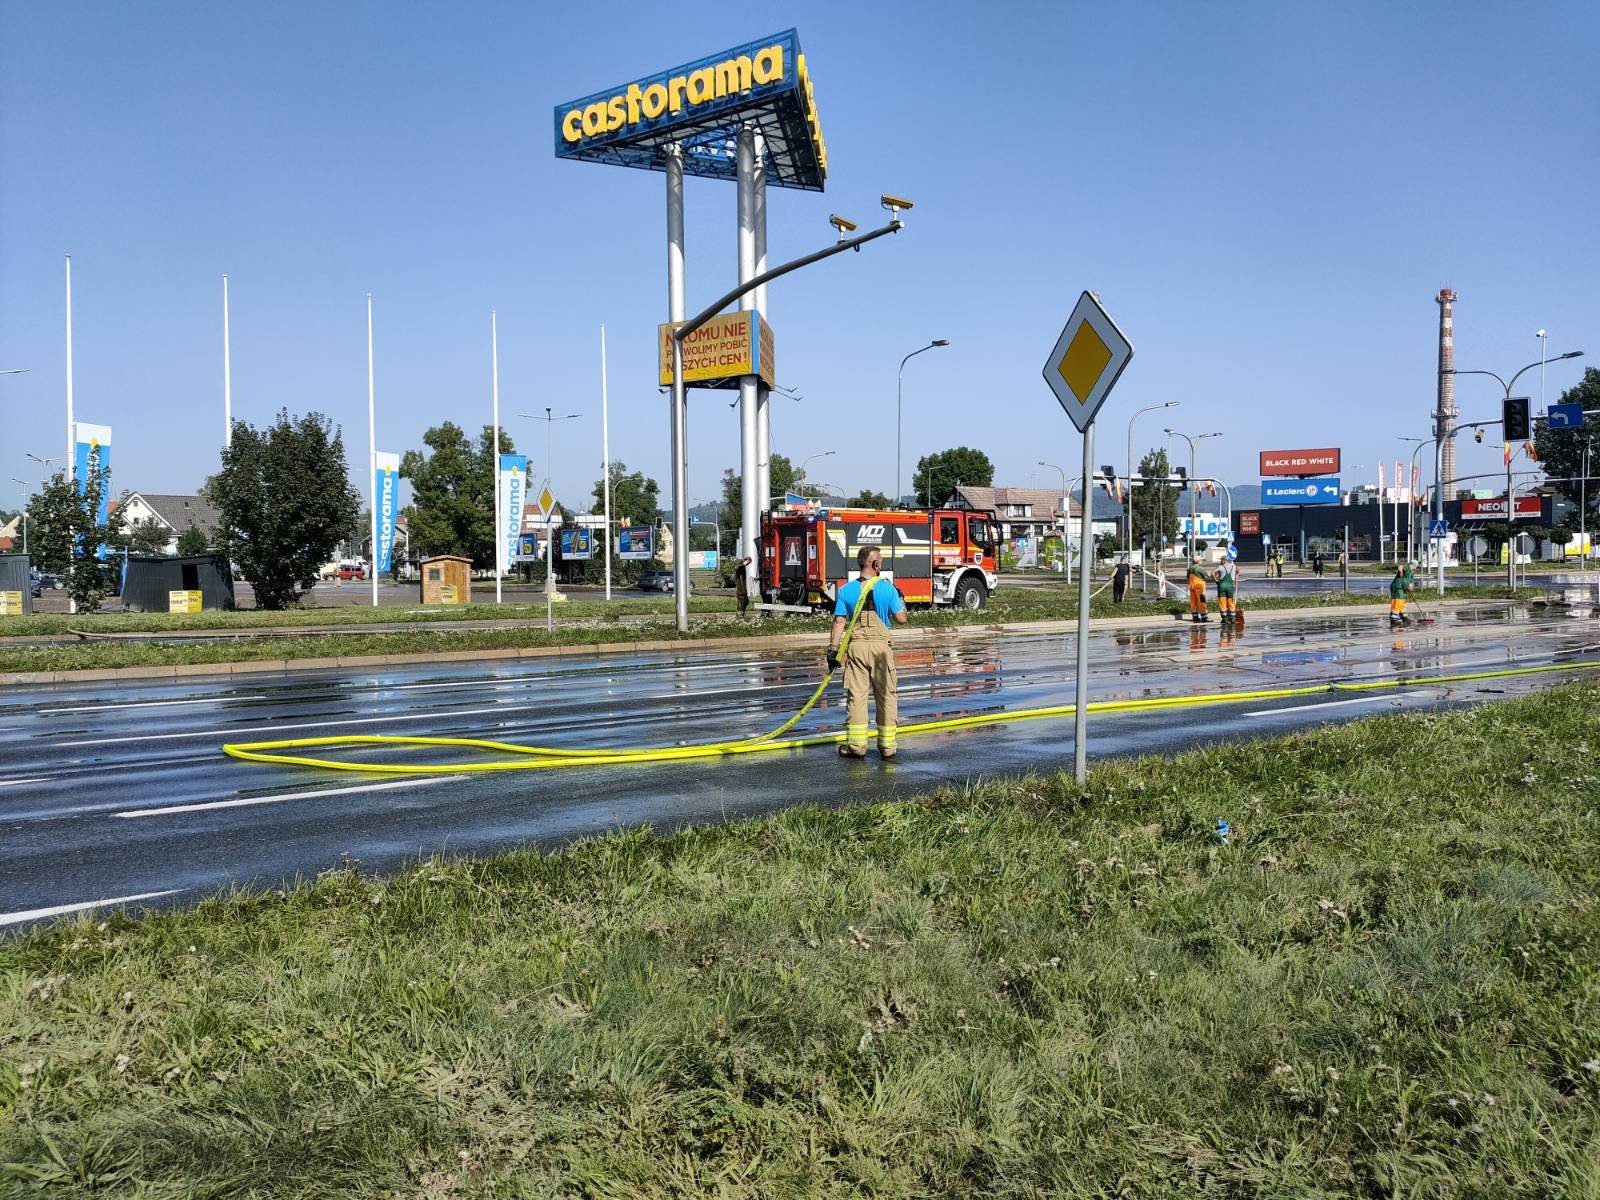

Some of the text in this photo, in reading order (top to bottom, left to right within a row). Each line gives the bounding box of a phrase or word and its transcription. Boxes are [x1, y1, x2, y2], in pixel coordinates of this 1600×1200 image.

[562, 45, 783, 143] castorama
[724, 322, 747, 338] NIE
[720, 339, 748, 351] POBIĆ
[666, 357, 717, 373] NSZYCH
[719, 354, 742, 366] CEN
[1309, 457, 1335, 465] WHITE
[379, 477, 393, 570] castorama
[507, 478, 521, 568] castorama
